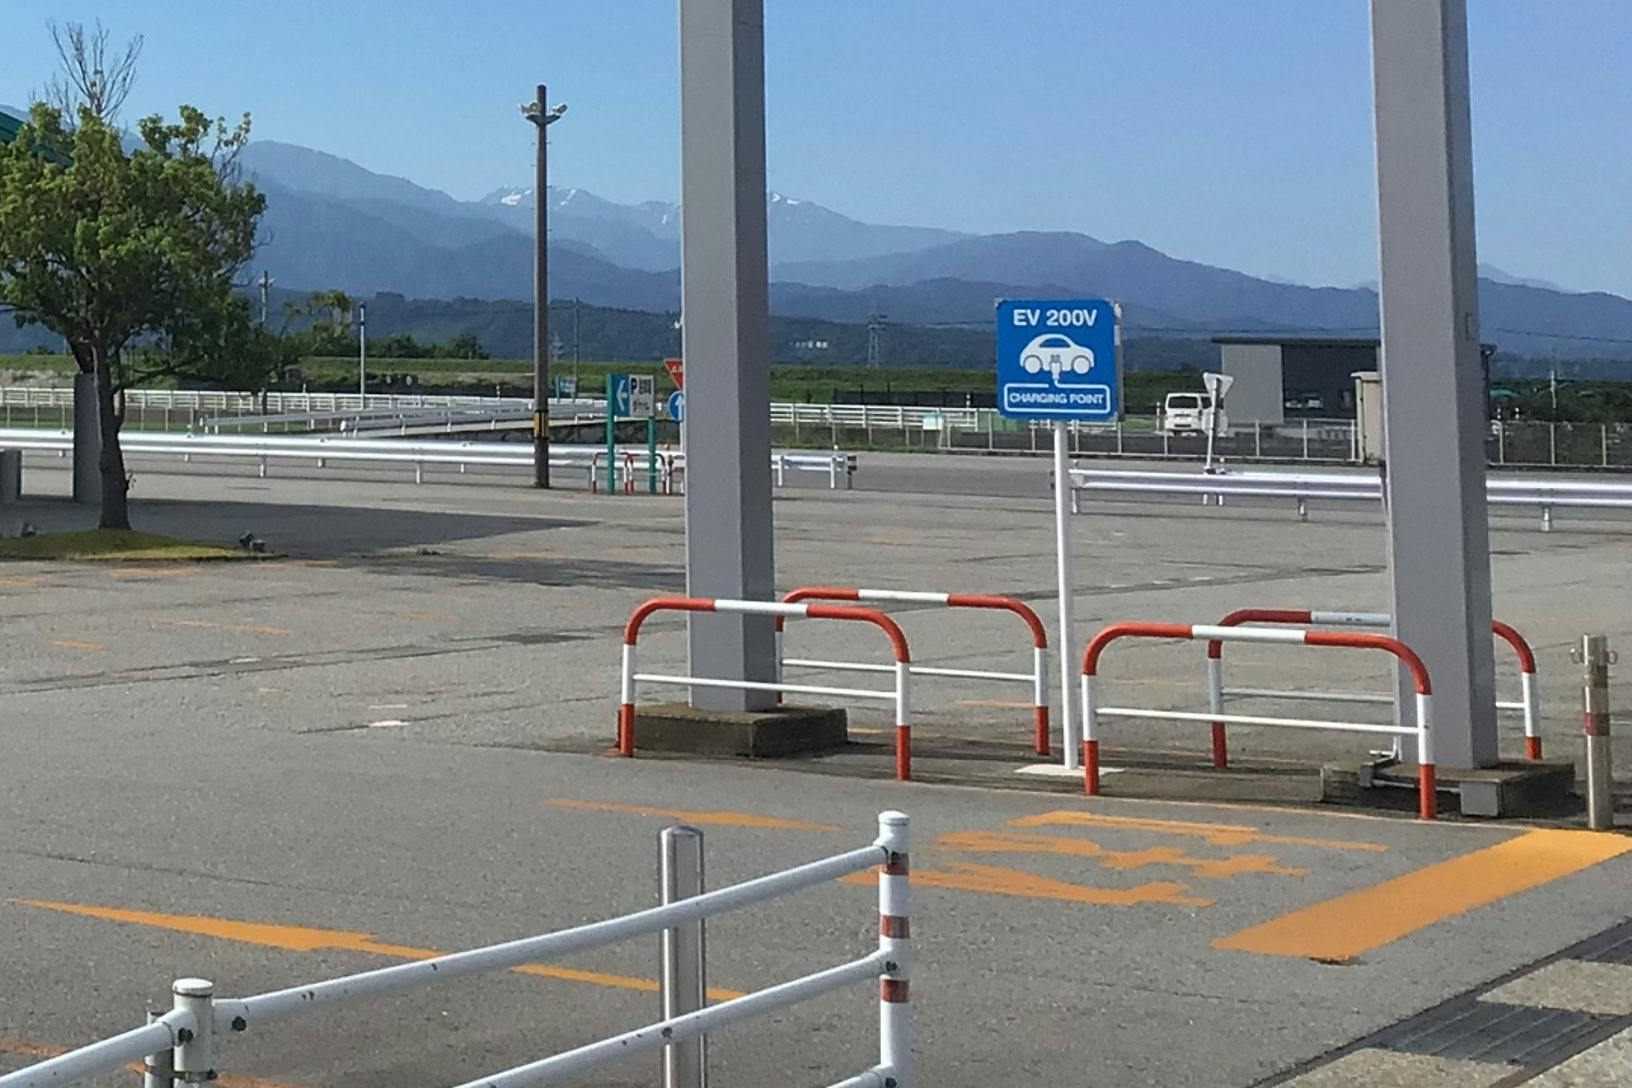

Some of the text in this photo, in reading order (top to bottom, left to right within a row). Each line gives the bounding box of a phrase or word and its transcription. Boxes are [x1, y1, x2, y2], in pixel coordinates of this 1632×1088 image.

[1012, 308, 1098, 326] EV 200V
[1009, 392, 1105, 405] CHARGING POINT
